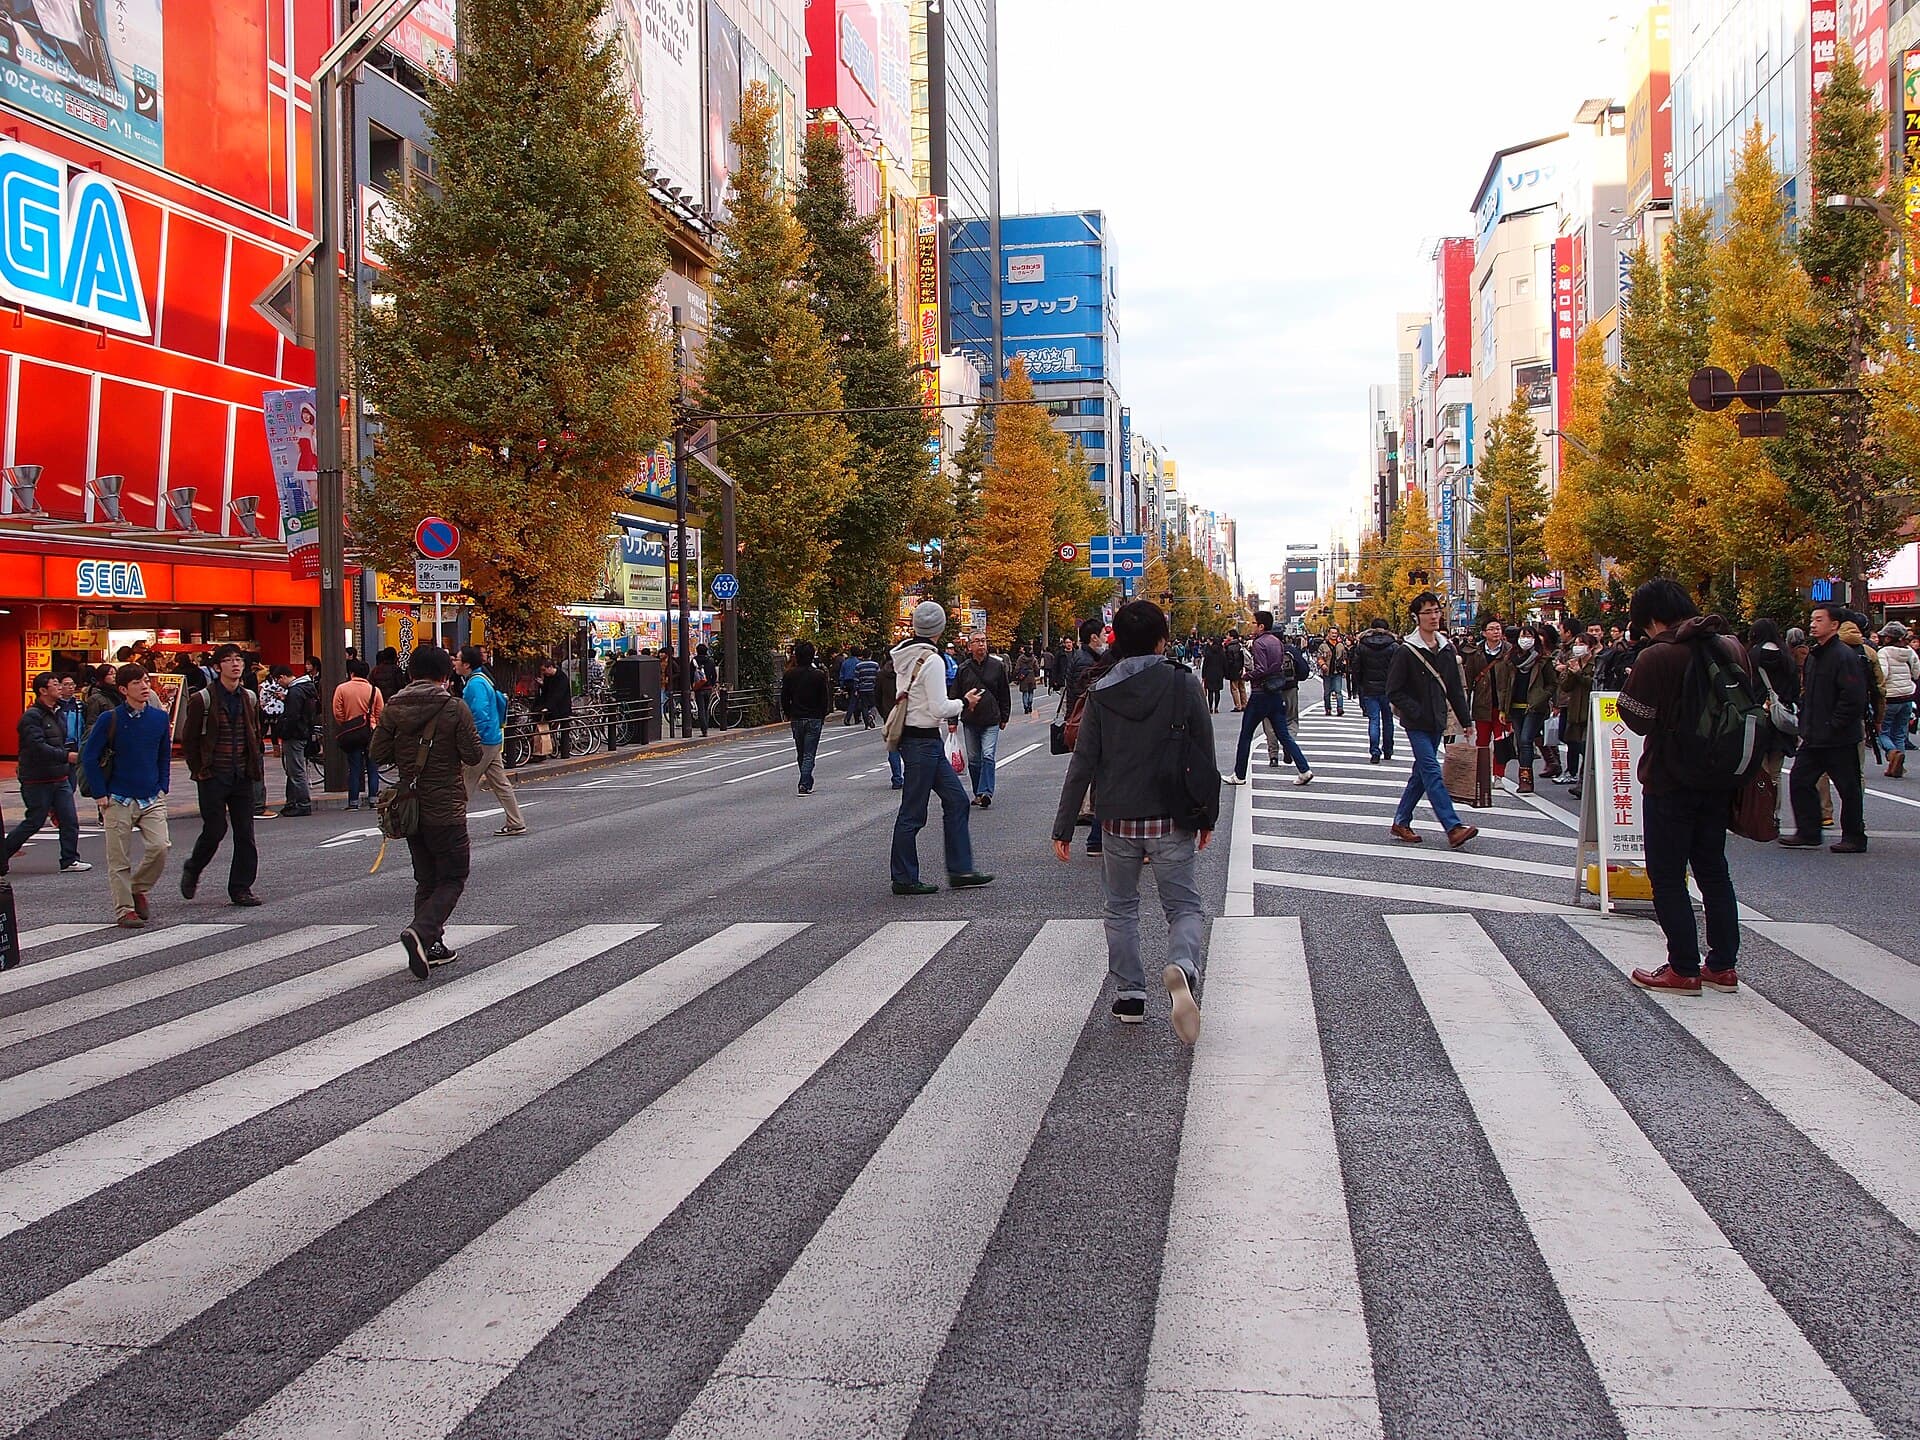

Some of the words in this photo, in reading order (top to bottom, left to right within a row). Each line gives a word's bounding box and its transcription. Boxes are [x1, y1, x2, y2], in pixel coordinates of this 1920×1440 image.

[645, 15, 659, 43] ON
[661, 31, 683, 67] SALE
[843, 14, 876, 102] SEGA
[920, 236, 934, 244] DVD
[922, 258, 933, 266] CD
[1011, 263, 1041, 271] ビックカメラ
[1558, 278, 1572, 338] 坂口電熱
[1062, 547, 1074, 557] 50
[79, 563, 144, 595] SEGA
[445, 581, 459, 589] 14m
[714, 581, 734, 592] 437
[1611, 737, 1633, 826] 自転車走行禁止
